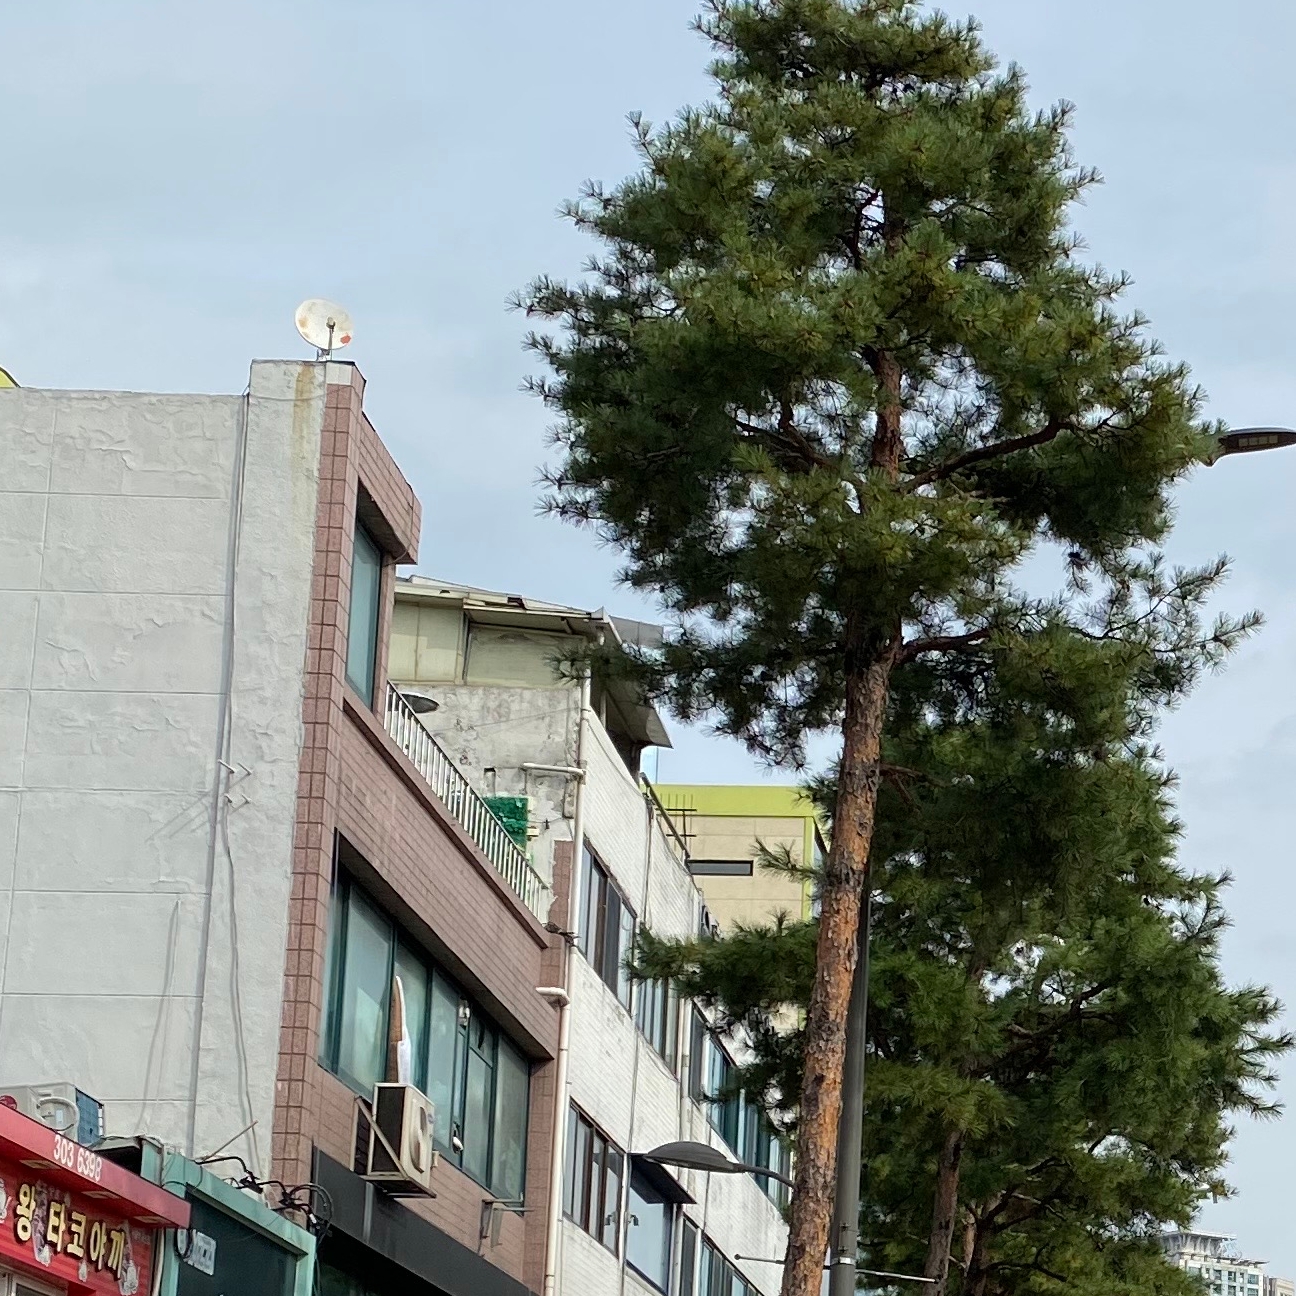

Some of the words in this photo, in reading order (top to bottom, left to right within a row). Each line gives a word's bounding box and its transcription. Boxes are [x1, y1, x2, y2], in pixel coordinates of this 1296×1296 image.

[53, 1134, 74, 1167] 303
[77, 1149, 103, 1182] 6398
[16, 1183, 36, 1242] 왕
[47, 1202, 126, 1279] 타코야끼
